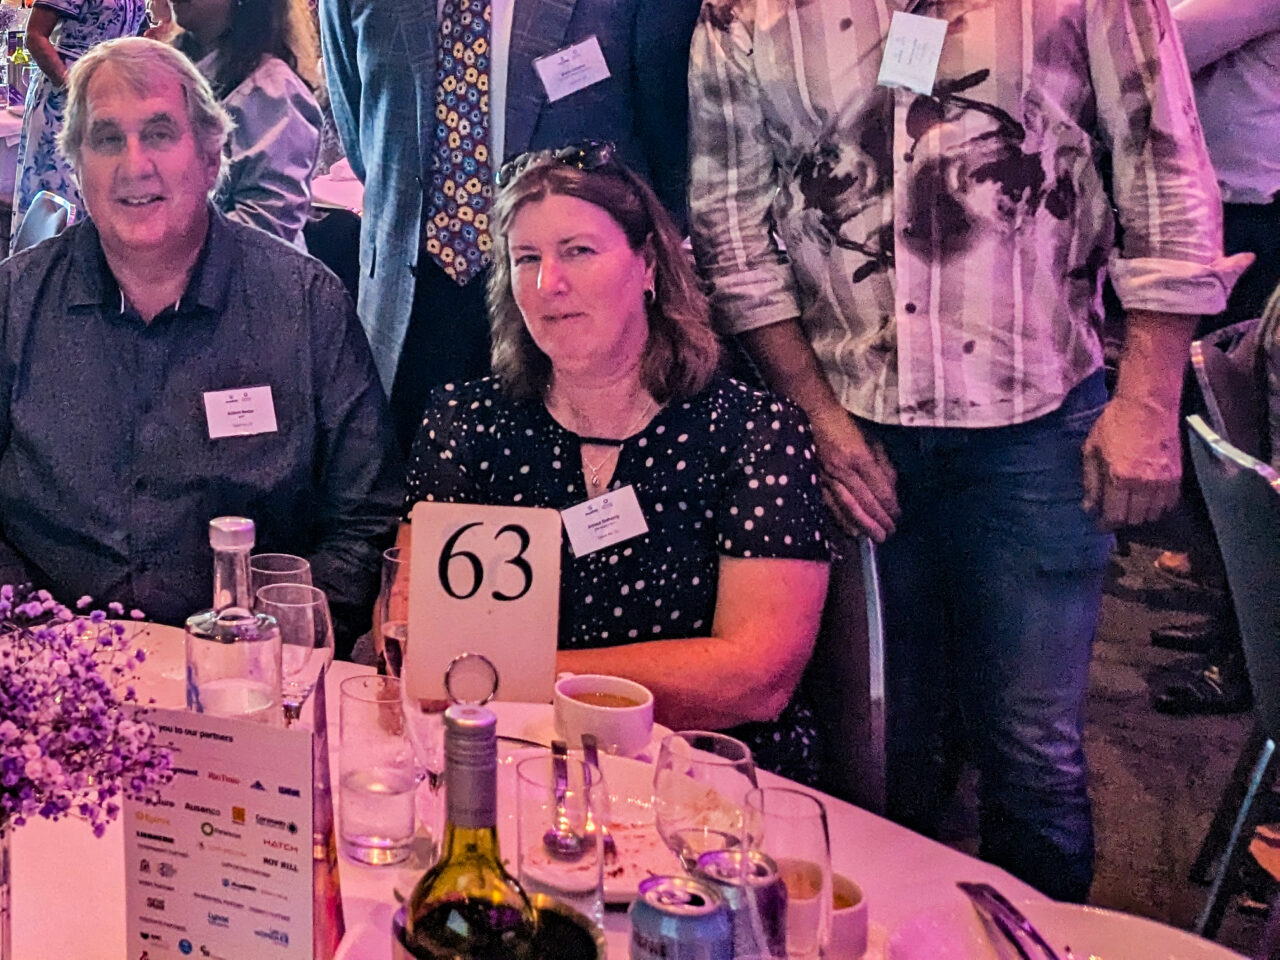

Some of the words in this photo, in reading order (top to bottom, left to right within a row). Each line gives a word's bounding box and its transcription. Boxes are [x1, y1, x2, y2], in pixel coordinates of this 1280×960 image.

[437, 521, 533, 601] 63
[159, 725, 173, 733] you
[174, 726, 183, 734] to
[184, 728, 197, 736] our
[200, 731, 233, 742] partners
[263, 839, 298, 853] HATCH
